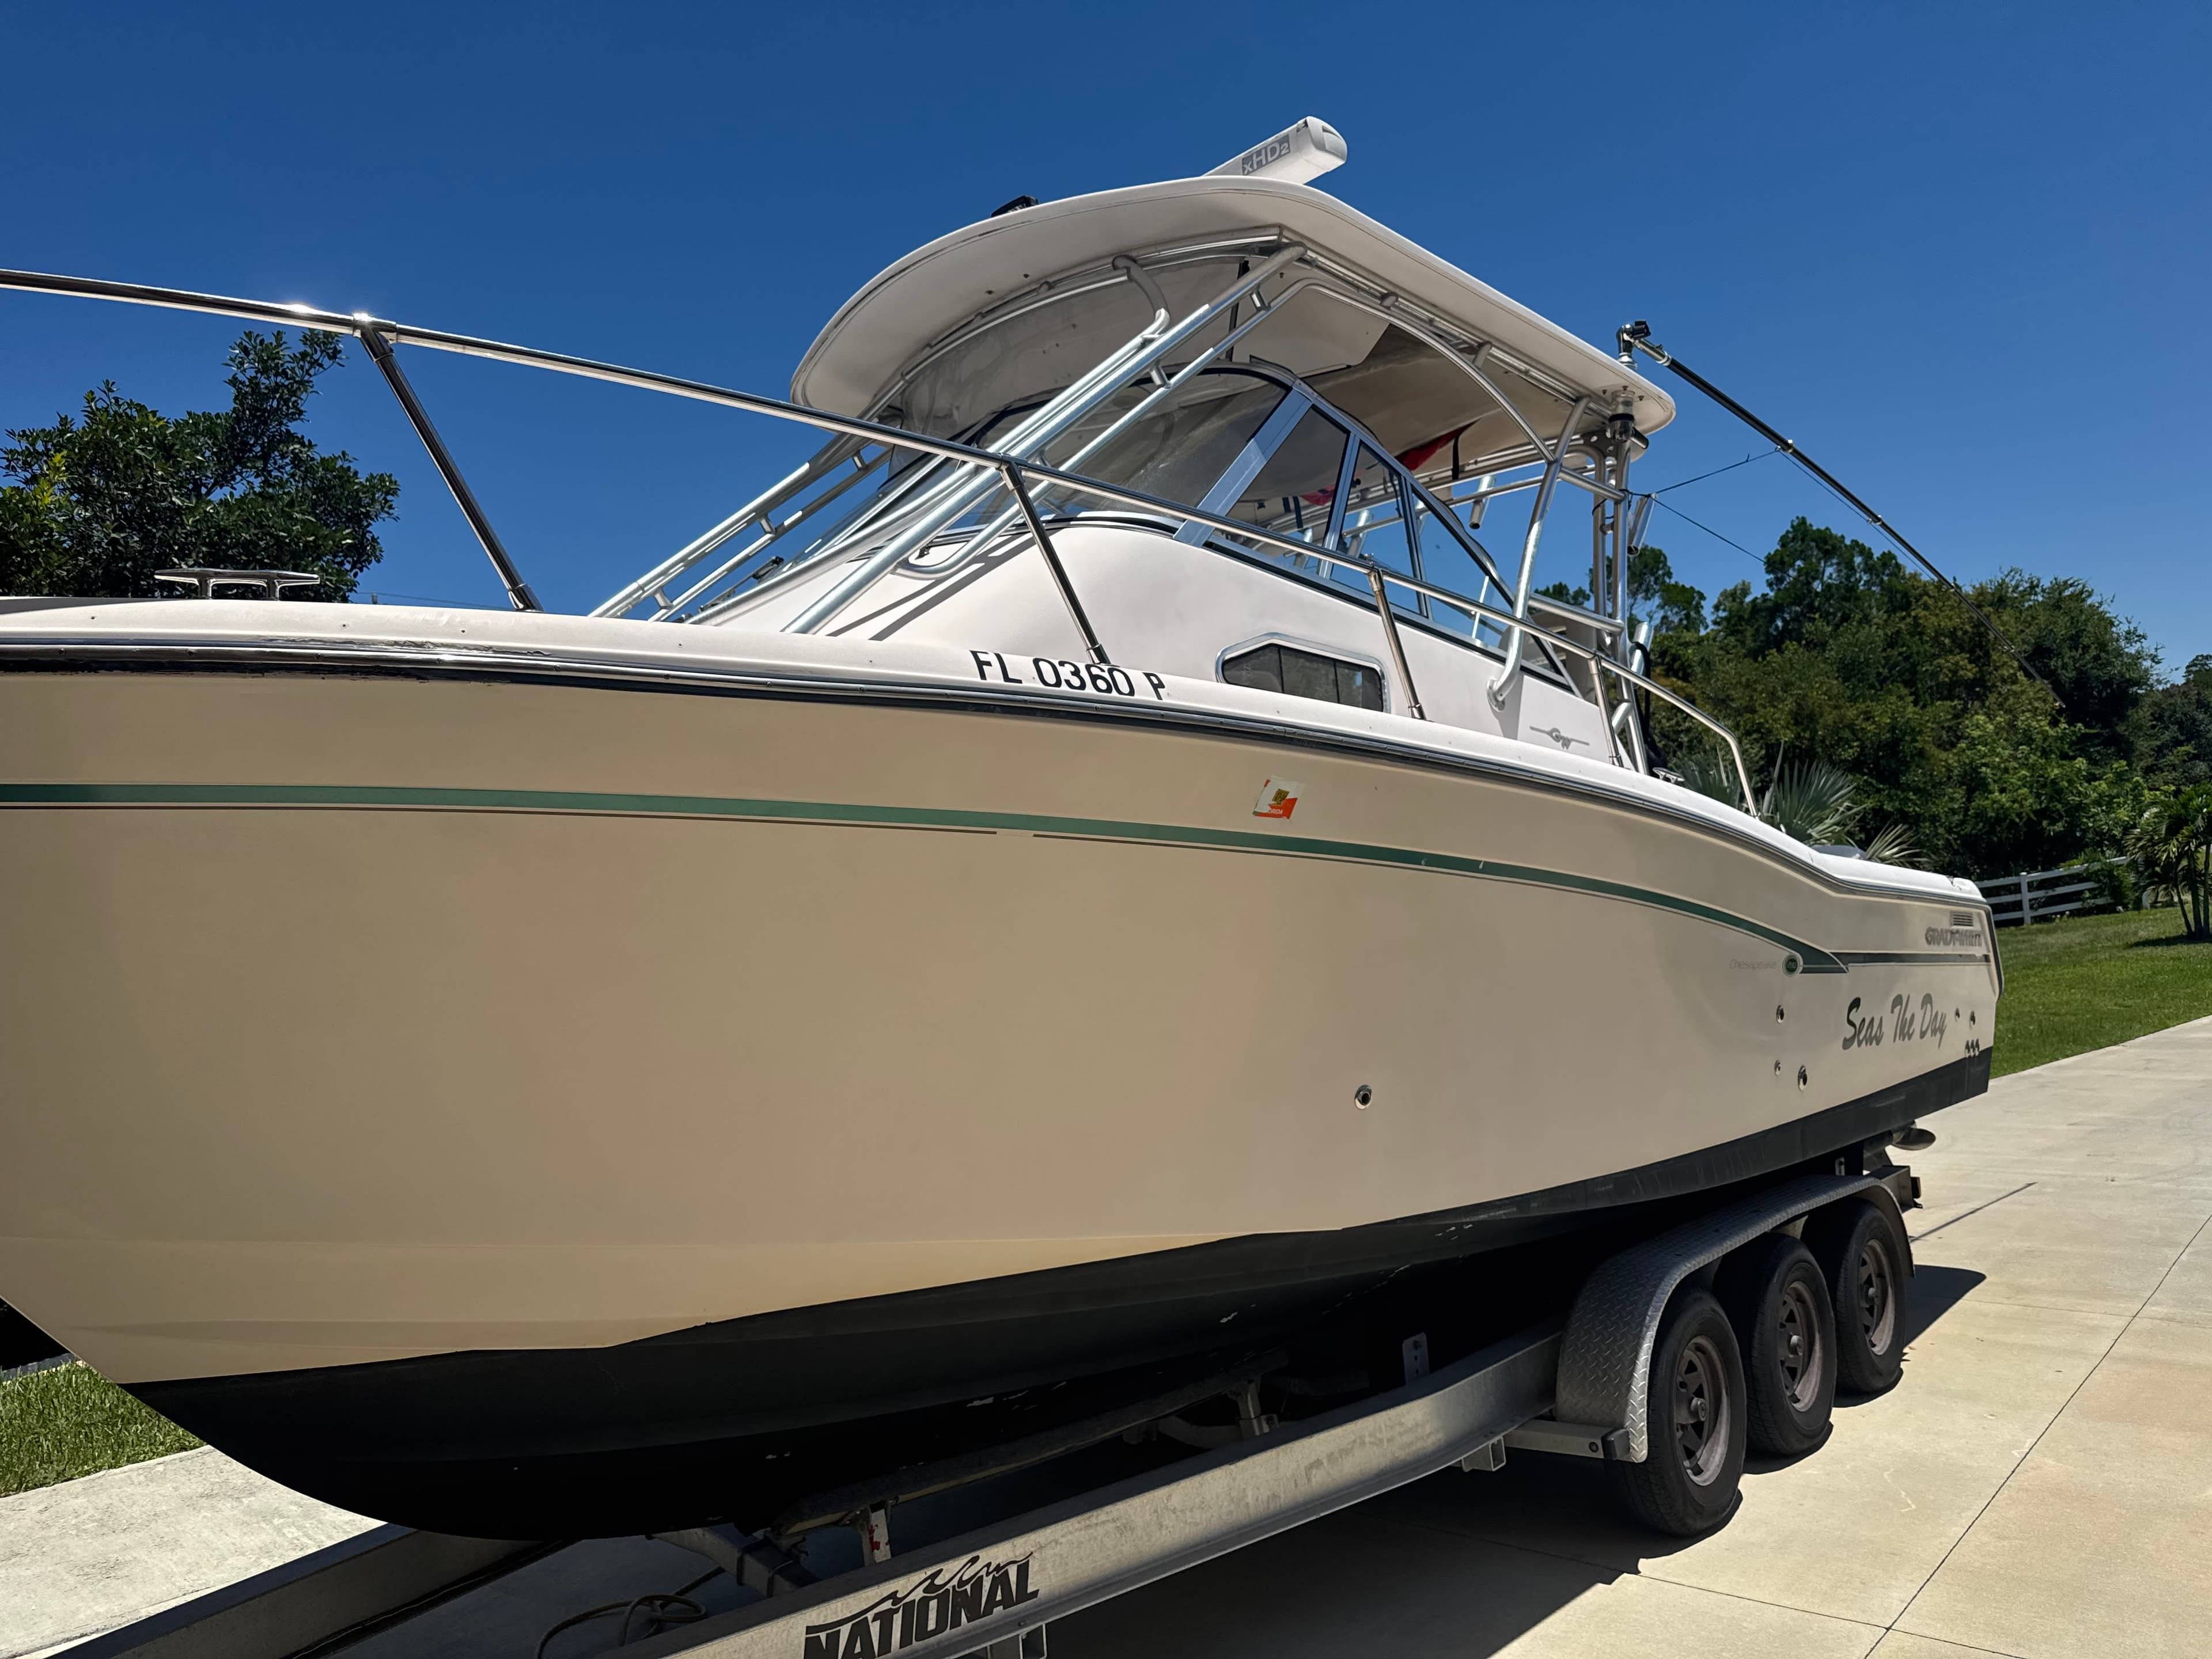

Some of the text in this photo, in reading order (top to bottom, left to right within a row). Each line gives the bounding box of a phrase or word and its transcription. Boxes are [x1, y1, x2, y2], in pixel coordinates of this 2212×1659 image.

[970, 650, 1165, 700] FL 0360 P
[1842, 993, 1946, 1050] Seas The Day
[805, 1559, 1040, 1659] NATIONAL
